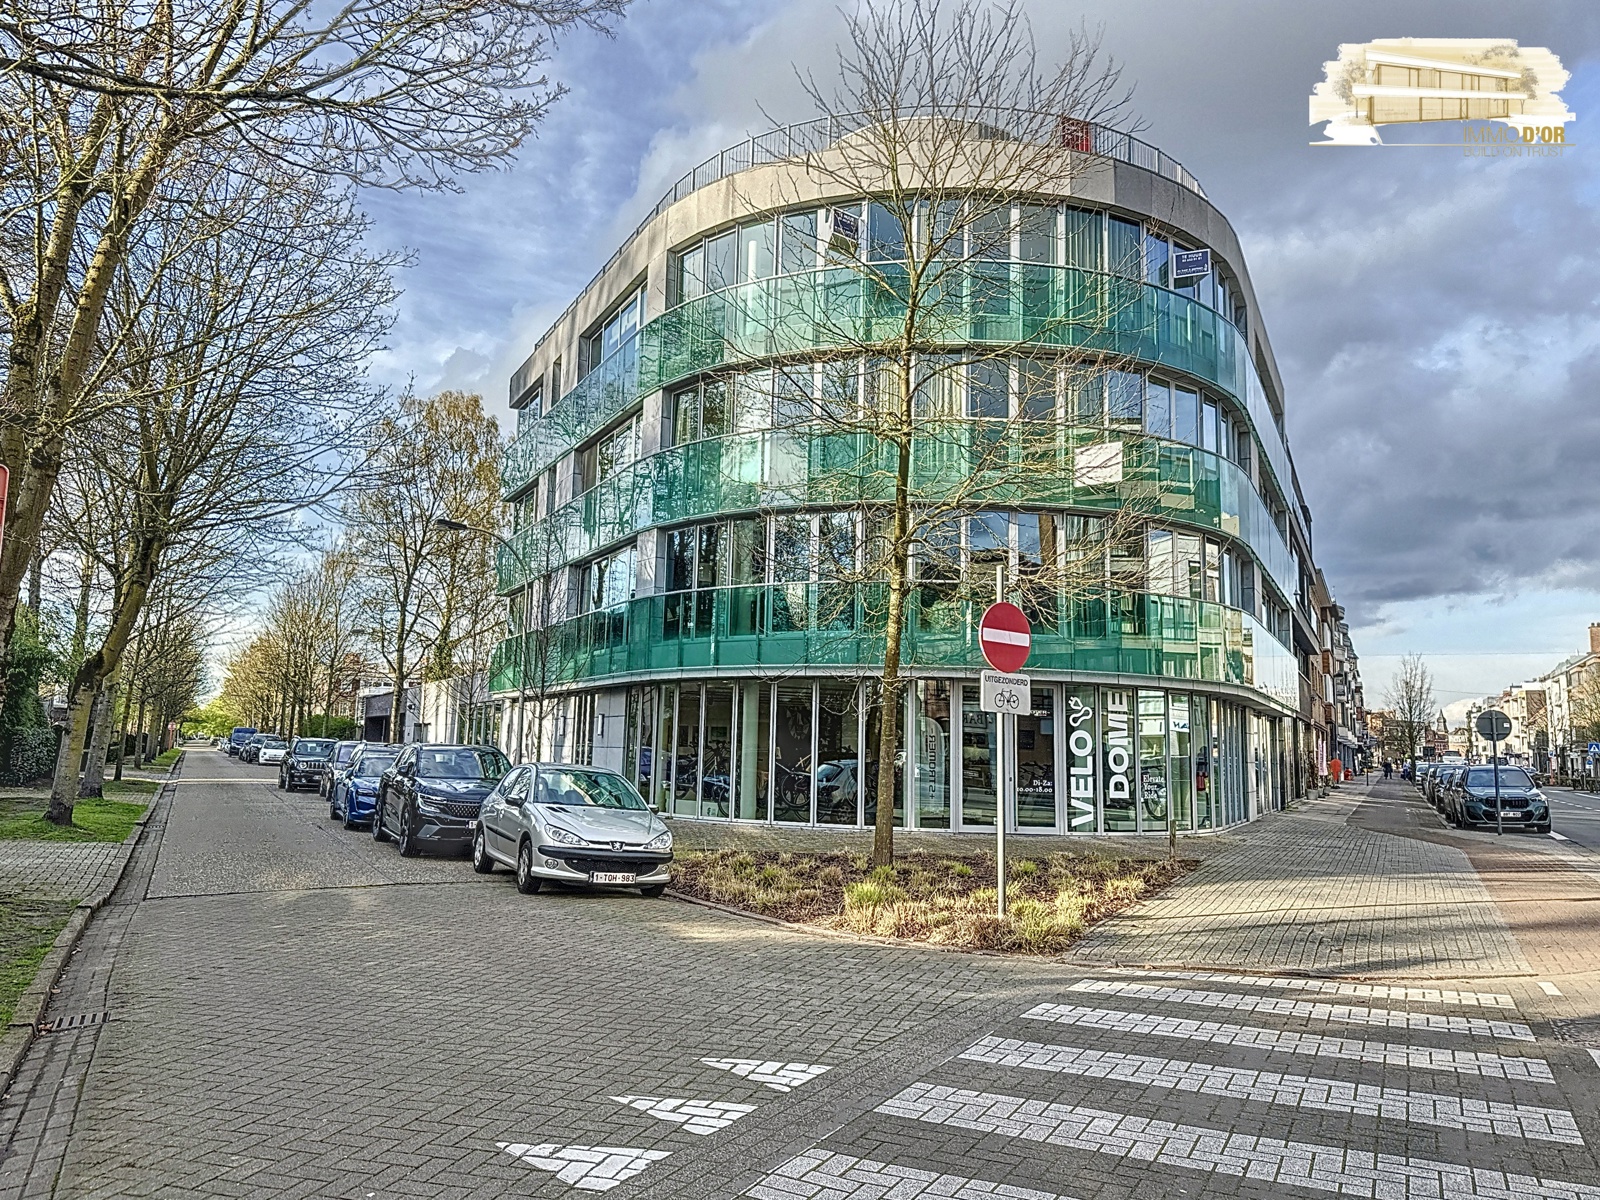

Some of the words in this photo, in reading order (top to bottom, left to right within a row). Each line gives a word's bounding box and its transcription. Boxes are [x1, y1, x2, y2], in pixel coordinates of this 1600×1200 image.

[984, 674, 1029, 687] UITGEZONDERD
[1107, 690, 1130, 798] DOME
[1069, 729, 1094, 827] VELO
[1142, 775, 1165, 783] Elevate
[1143, 783, 1158, 791] Your
[595, 873, 635, 883] 1-TOH-983
